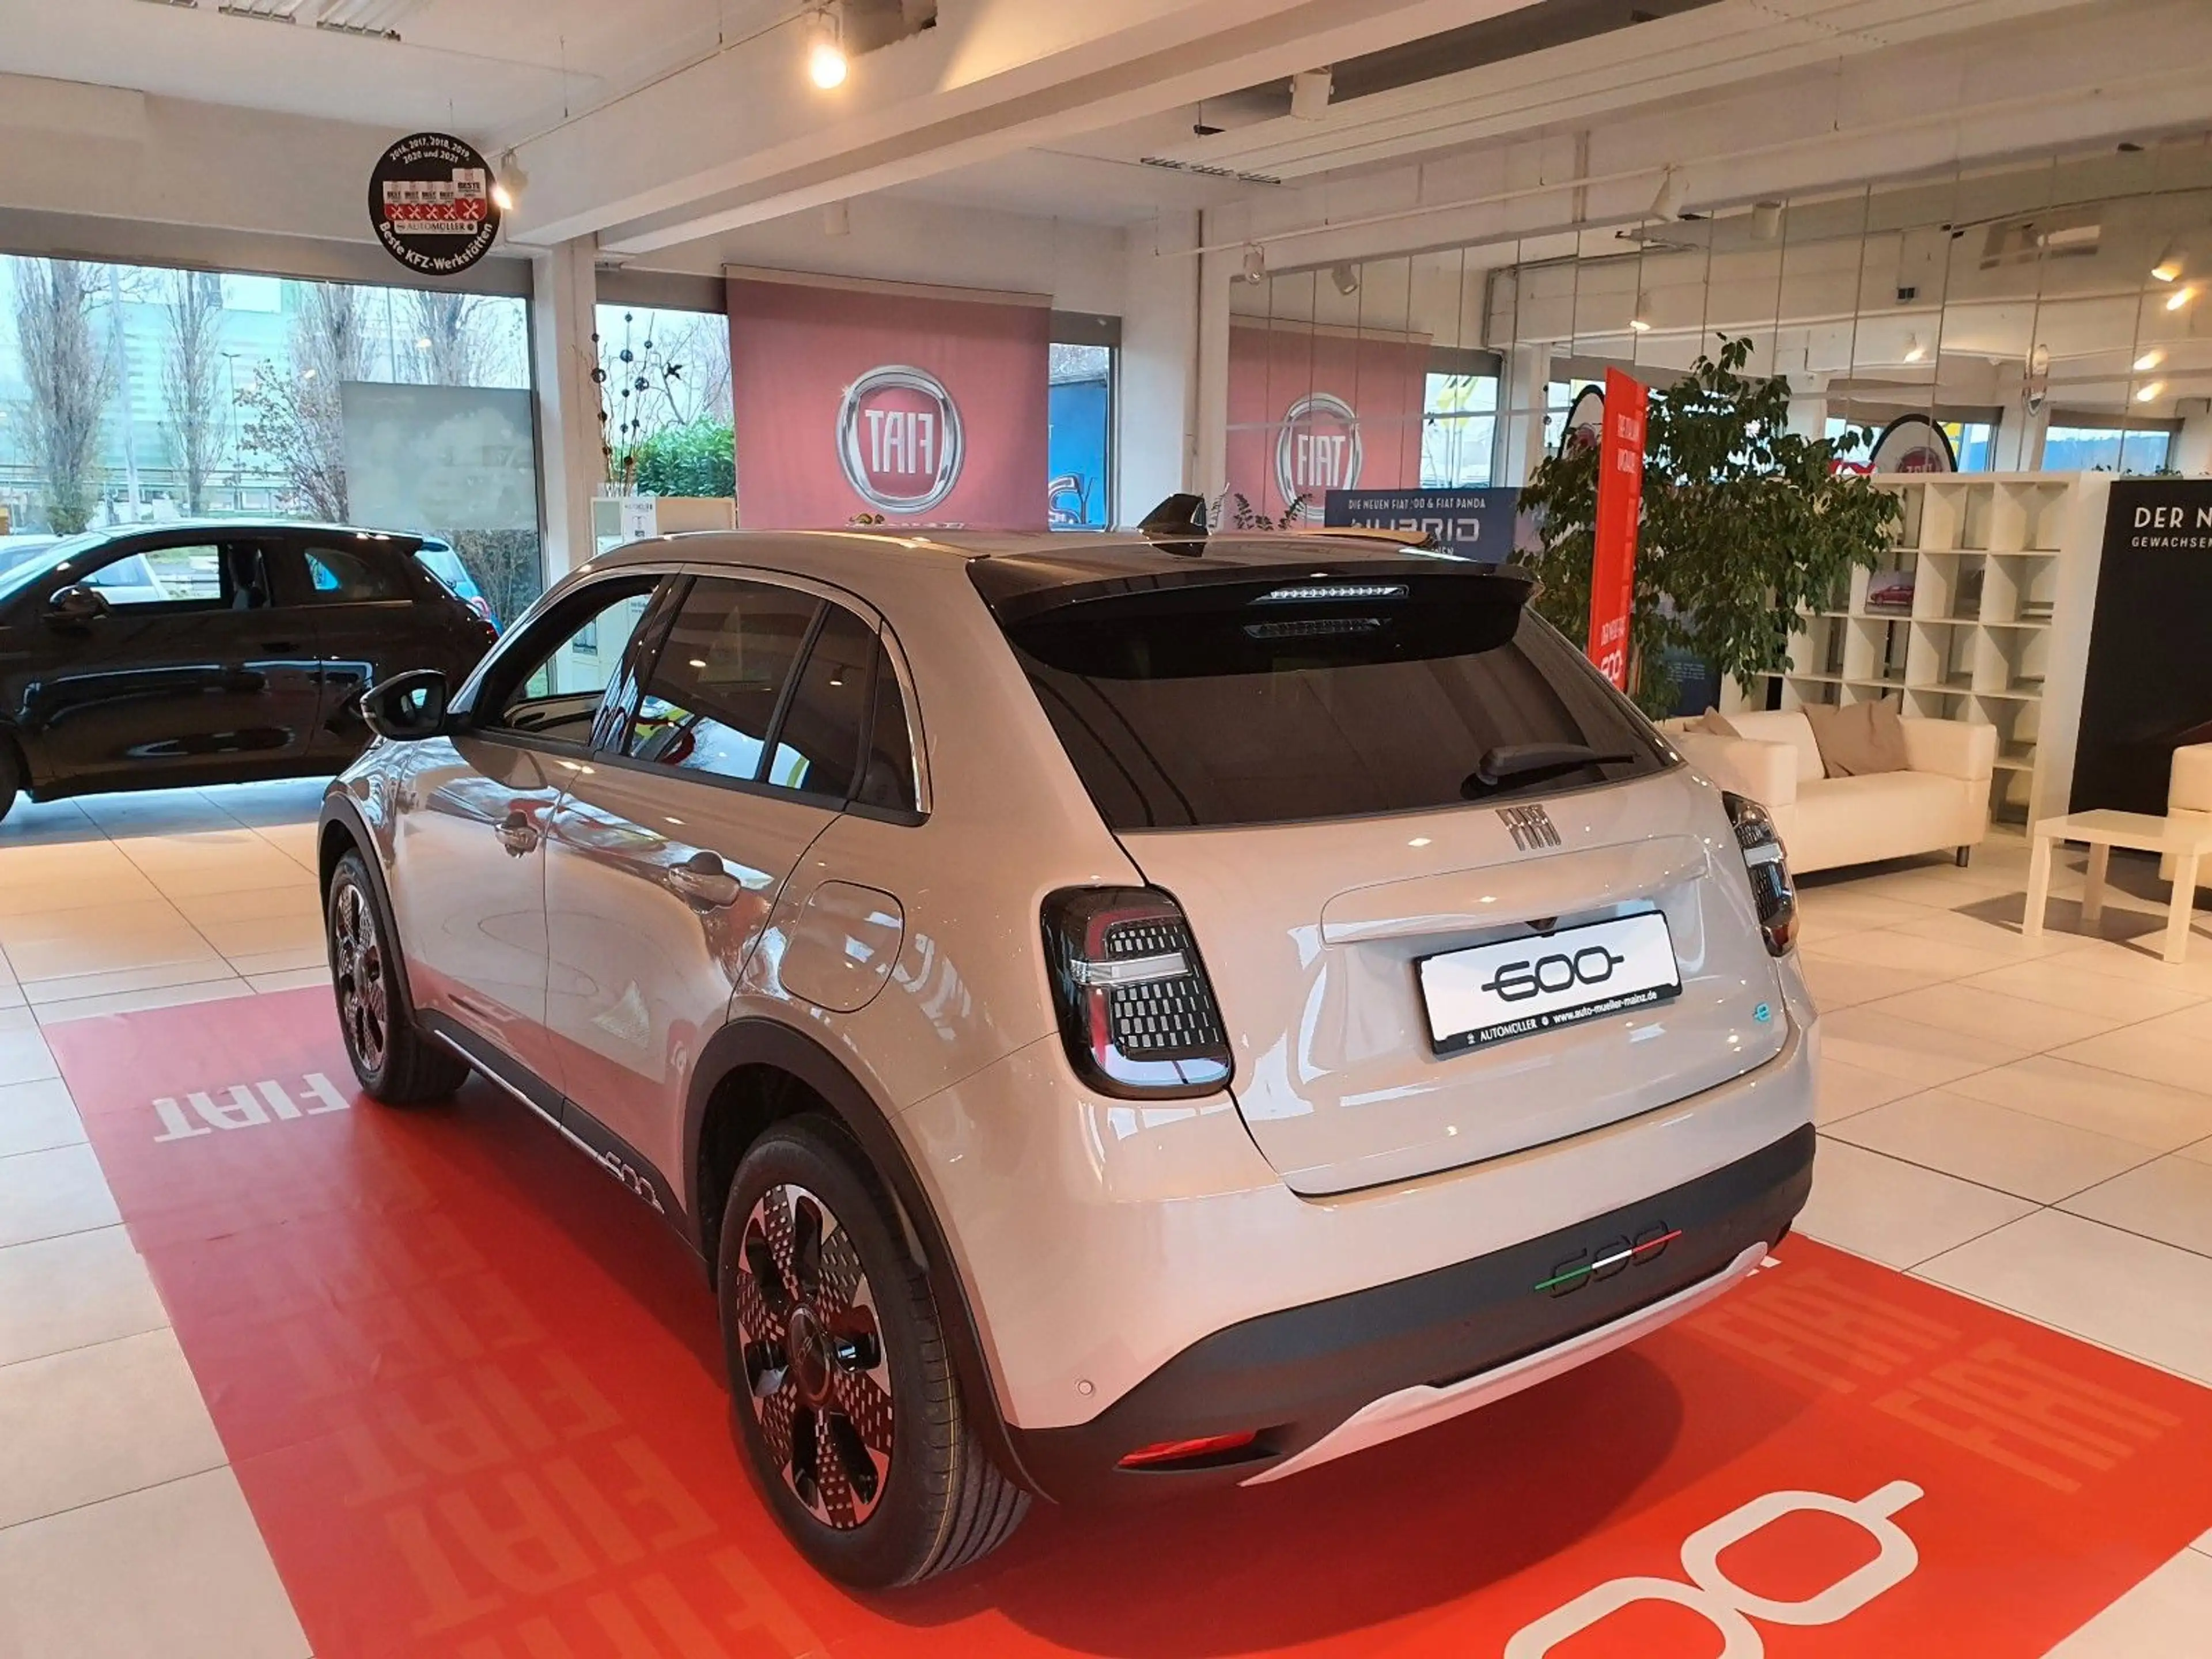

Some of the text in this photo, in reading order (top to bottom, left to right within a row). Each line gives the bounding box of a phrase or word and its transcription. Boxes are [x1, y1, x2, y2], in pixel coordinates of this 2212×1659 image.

[423, 149, 438, 158] und
[440, 150, 459, 163] 2021
[380, 222, 493, 270] Beste KFZ-Werkstätten
[1297, 434, 1346, 487] FIAT
[1349, 499, 1361, 510] DIE
[1363, 499, 1389, 510] NEUEN
[1392, 499, 1409, 510] FIAT
[1436, 498, 1453, 509] FIAT
[1456, 498, 1486, 509] PANDA
[2134, 507, 2184, 528] DER
[1481, 945, 1624, 1002] 600
[1553, 990, 1657, 1024] www.auto-mueller-mainz.de
[151, 1072, 350, 1143] FIAT
[1870, 1338, 2185, 1493] FIAT
[384, 1434, 719, 1639] FIAT
